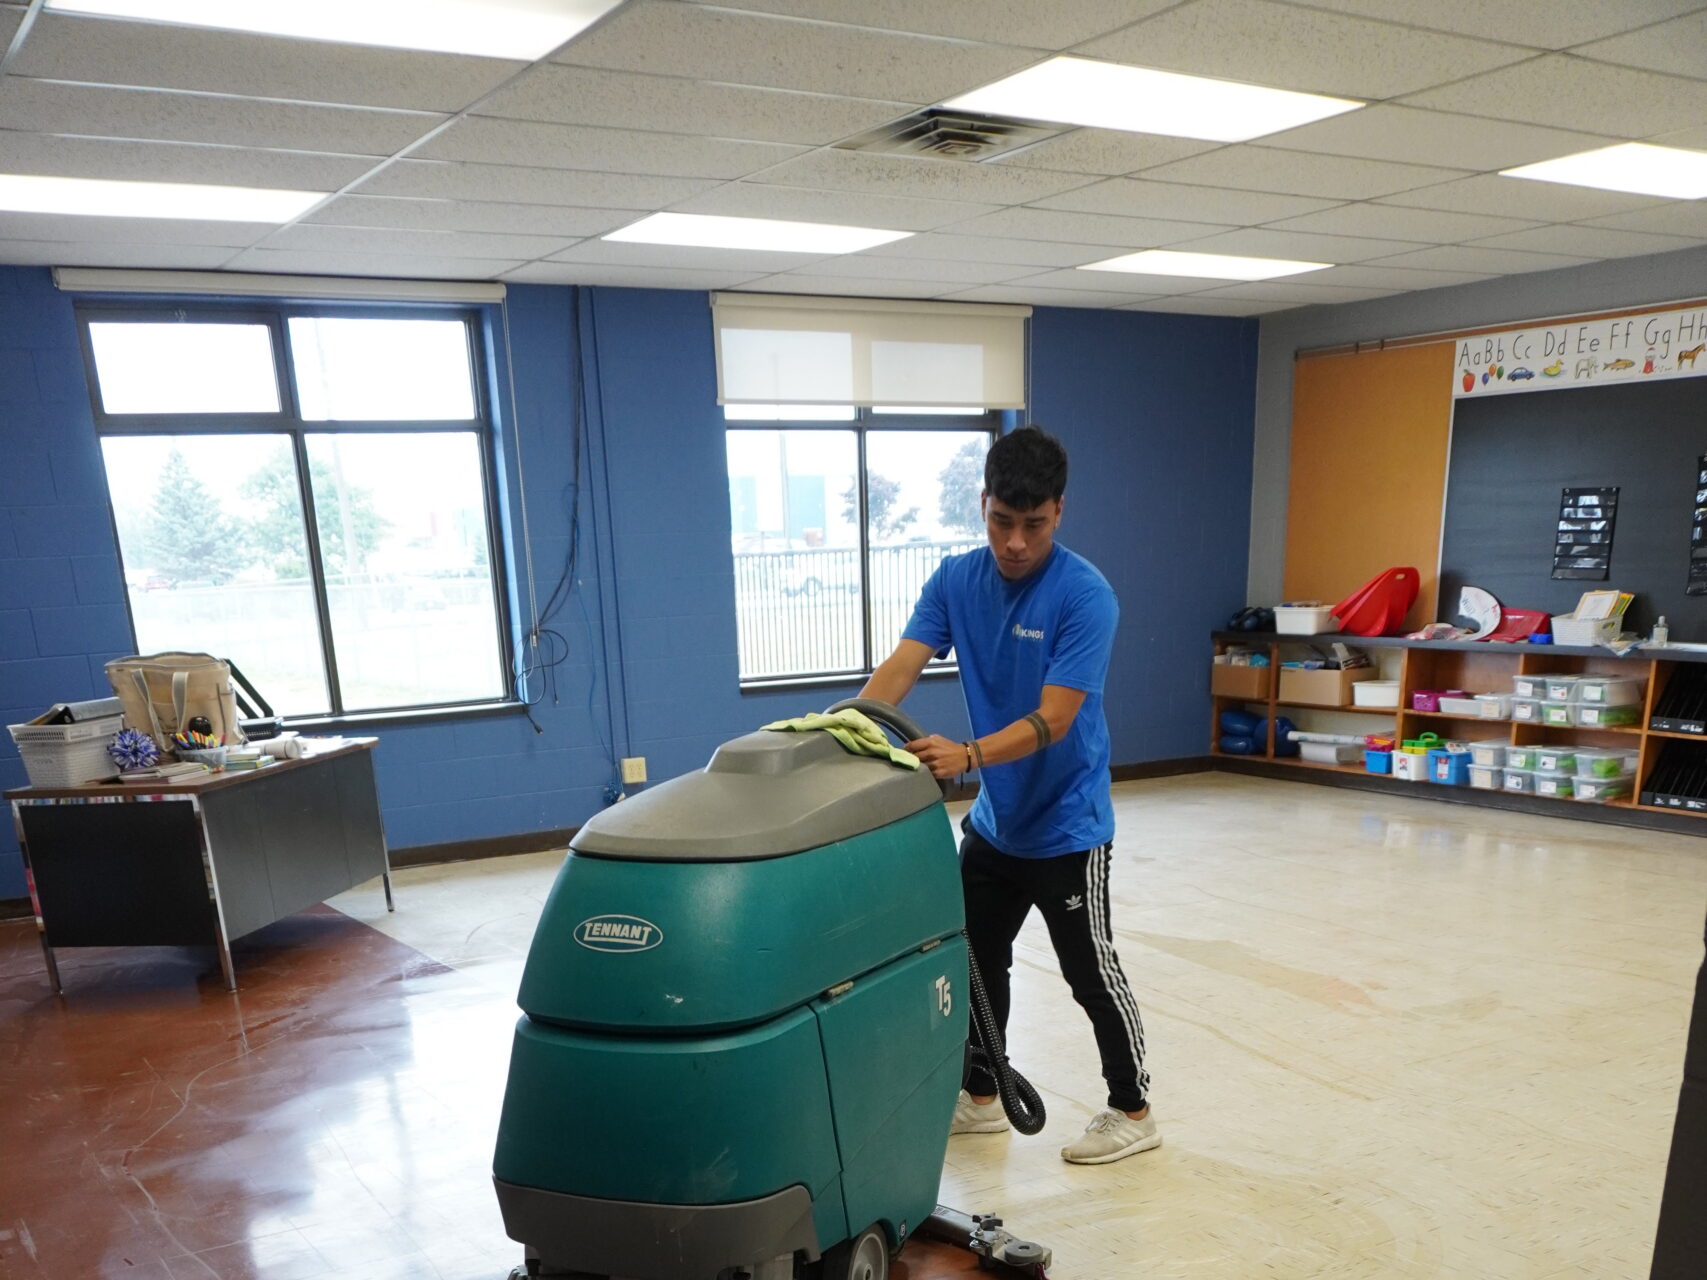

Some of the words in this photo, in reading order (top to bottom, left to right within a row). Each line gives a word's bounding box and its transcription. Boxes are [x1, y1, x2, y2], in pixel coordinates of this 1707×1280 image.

[1512, 334, 1532, 360] Cc
[1543, 328, 1567, 357] Dd
[1576, 326, 1600, 354] Ee
[1609, 320, 1634, 351] Ff
[1643, 318, 1672, 360] Gg
[1677, 312, 1707, 343] Hh
[583, 922, 652, 946] TENNANT
[935, 975, 952, 1017] T5
